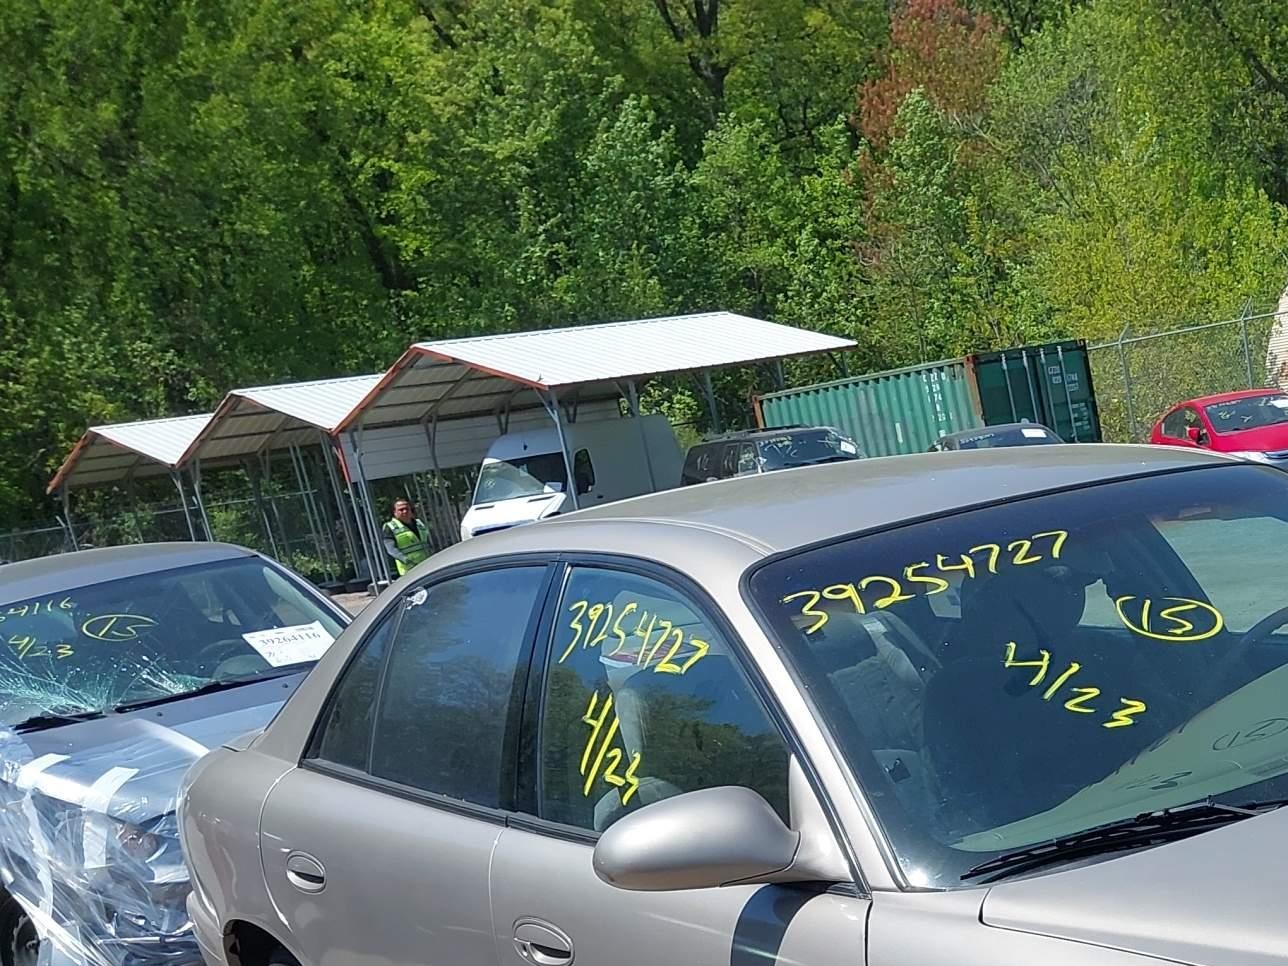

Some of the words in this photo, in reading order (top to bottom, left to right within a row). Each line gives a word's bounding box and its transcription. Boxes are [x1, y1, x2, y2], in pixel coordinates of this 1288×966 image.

[0, 597, 72, 621] 4116
[783, 530, 1068, 634] 39254727
[559, 600, 709, 674] 39254727
[1005, 641, 1147, 728] 4/23
